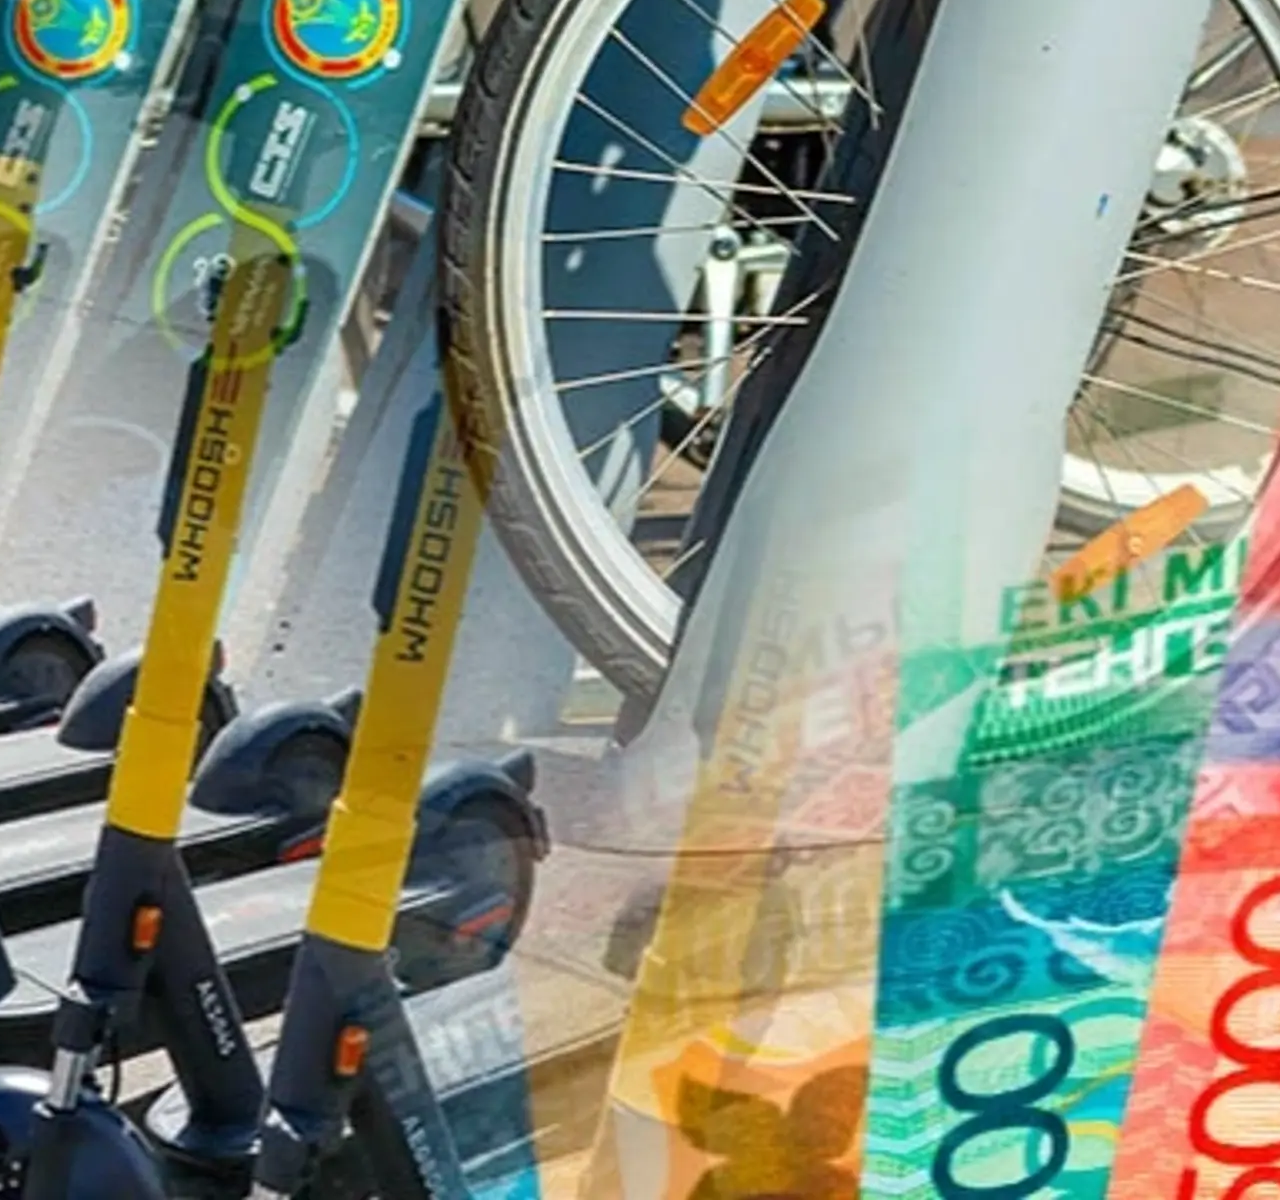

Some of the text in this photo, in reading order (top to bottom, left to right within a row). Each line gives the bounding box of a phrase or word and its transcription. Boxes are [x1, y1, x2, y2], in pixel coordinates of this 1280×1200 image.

[249, 100, 308, 199] CTS
[173, 404, 234, 582] WHOOSH
[395, 466, 466, 663] WHOOSH
